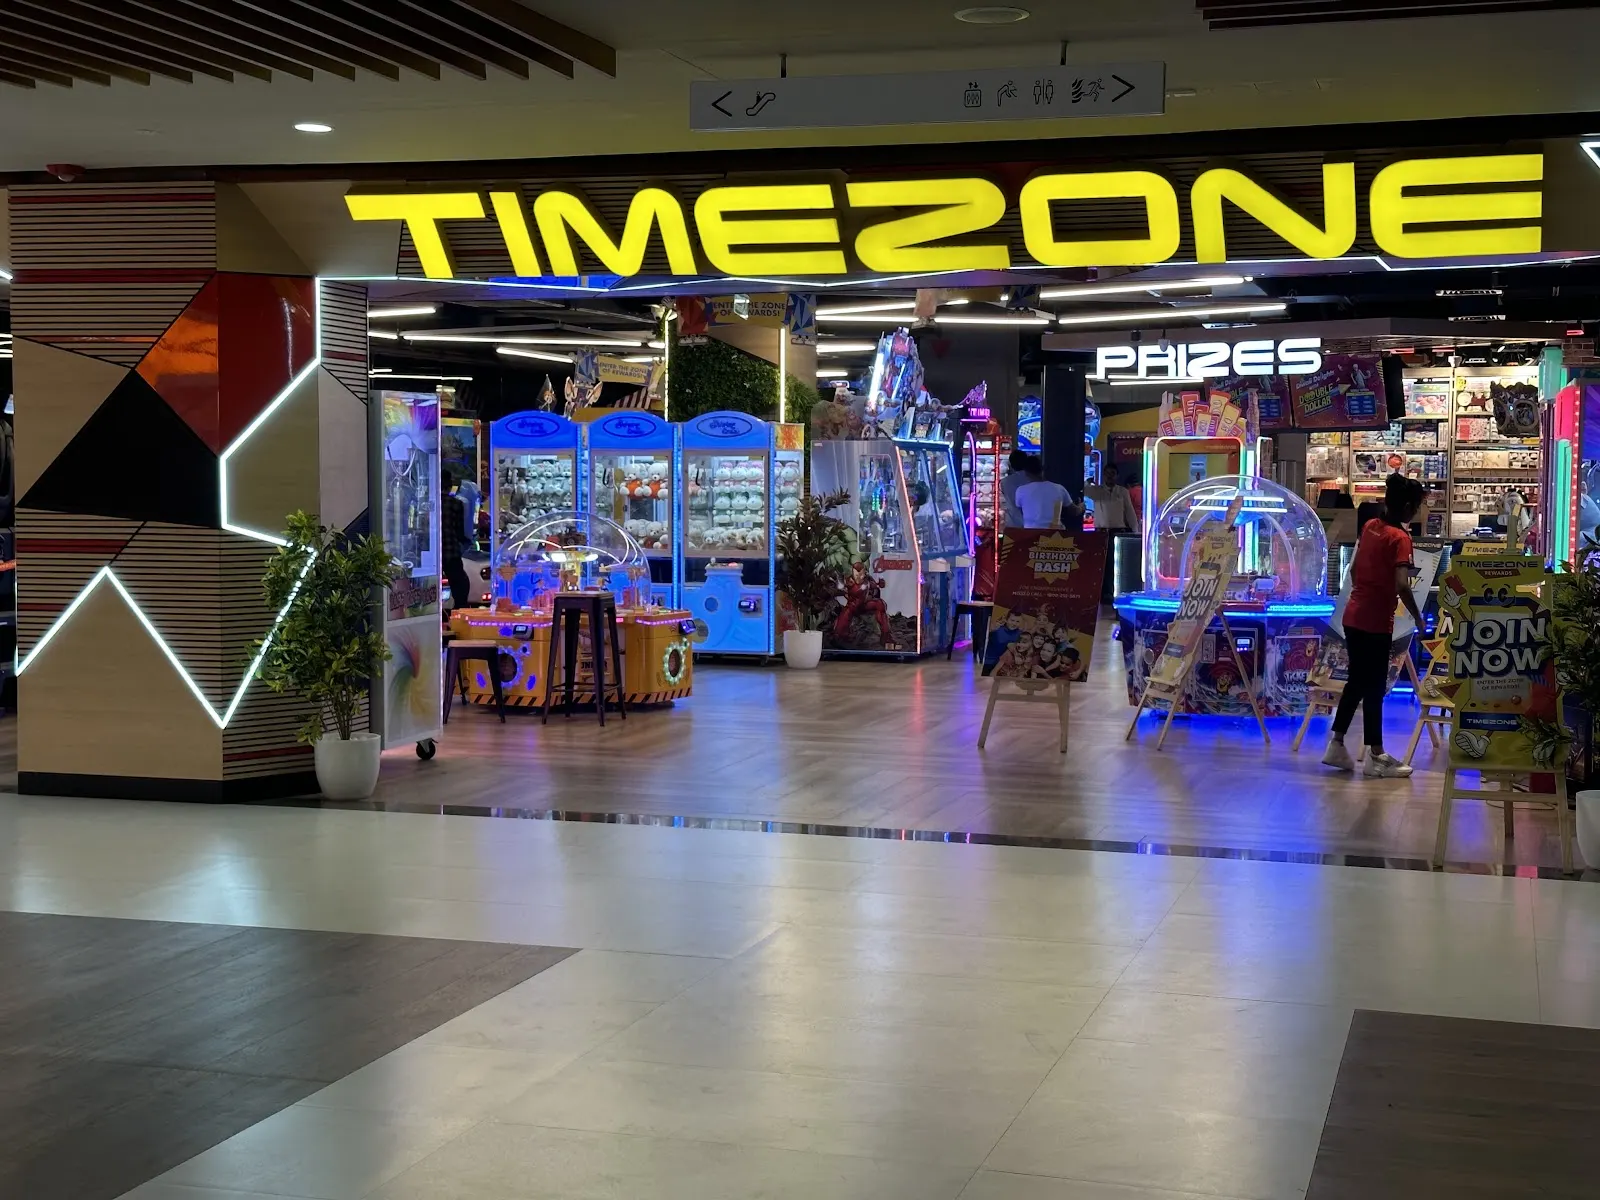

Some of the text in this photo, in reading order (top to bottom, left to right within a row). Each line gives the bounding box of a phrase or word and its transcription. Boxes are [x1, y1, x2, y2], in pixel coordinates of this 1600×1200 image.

[344, 153, 1543, 278] TIMEZONE
[713, 301, 736, 309] ENTE
[1096, 338, 1322, 379] PRIZES
[1304, 395, 1332, 414] DOLLAR
[1028, 551, 1080, 561] BIRTHDAY
[1034, 562, 1071, 573] BASH
[1183, 578, 1219, 598] JOIN
[1177, 599, 1210, 617] NOW
[1451, 617, 1546, 647] JOIN
[1455, 648, 1544, 674] NOW
